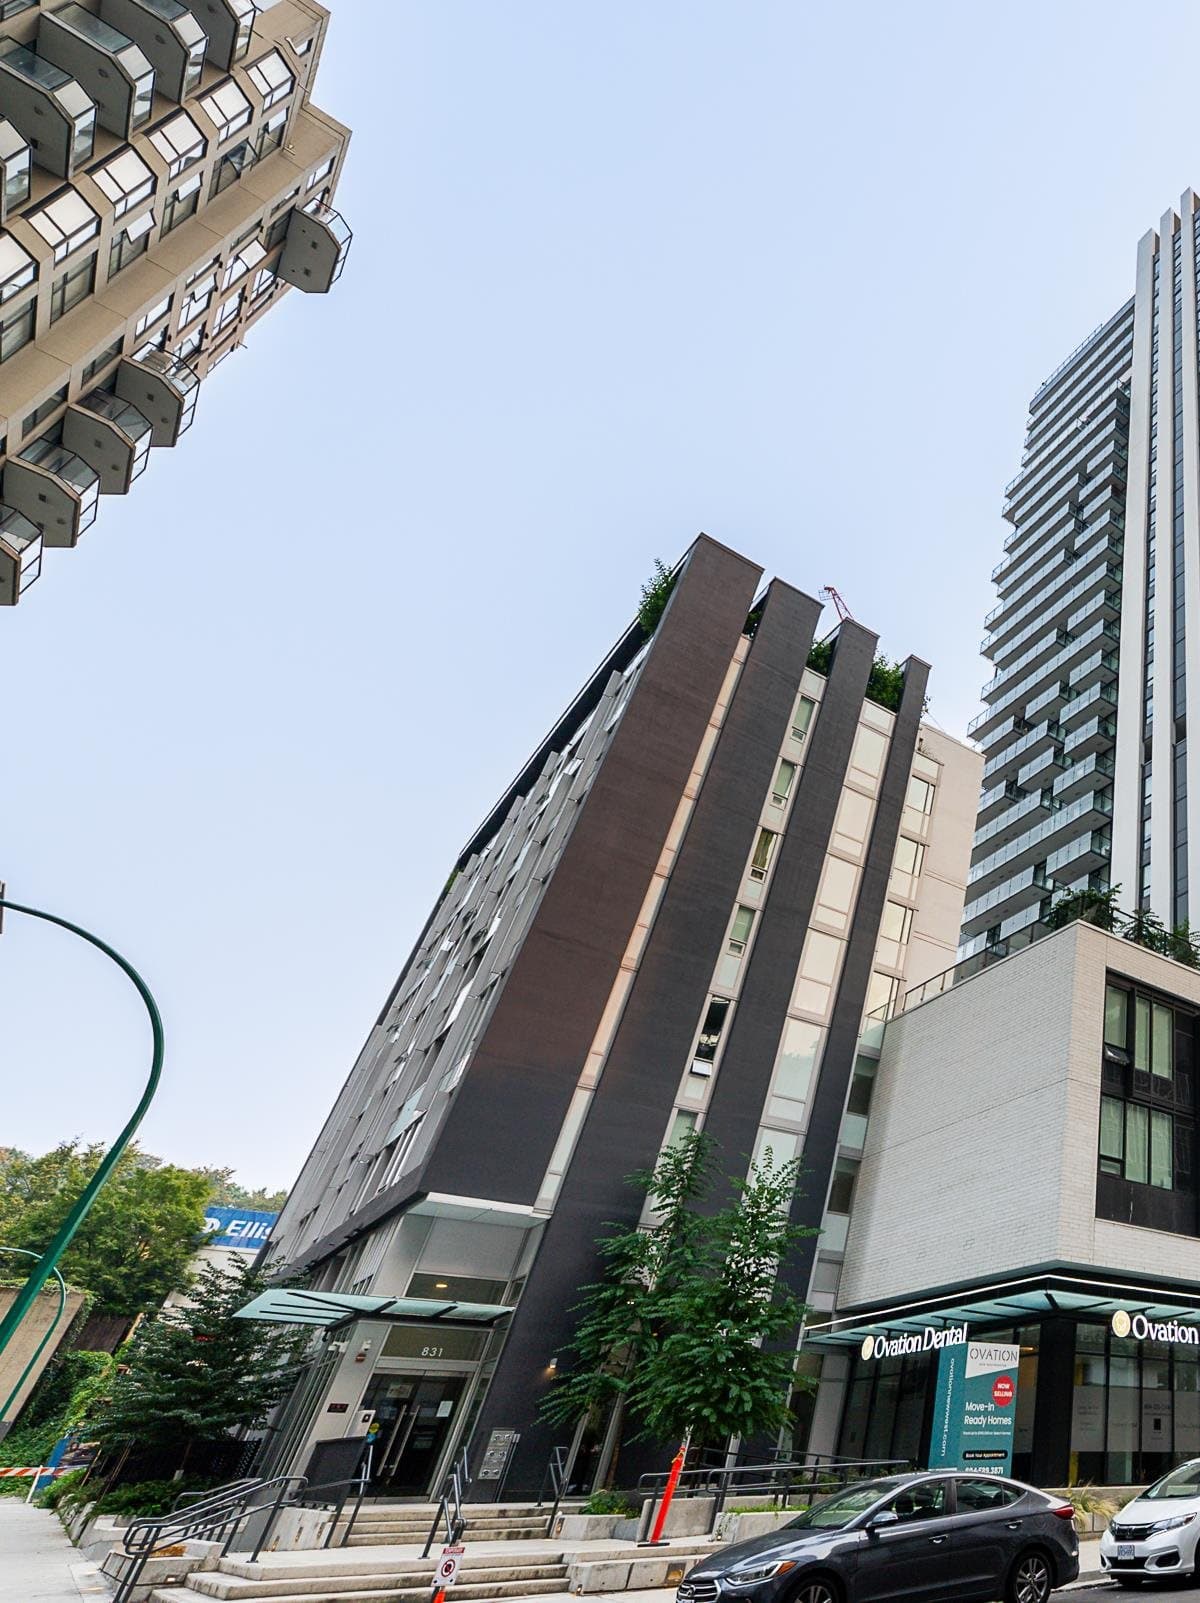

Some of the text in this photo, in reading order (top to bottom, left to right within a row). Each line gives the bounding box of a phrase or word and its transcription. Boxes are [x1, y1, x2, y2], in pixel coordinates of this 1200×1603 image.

[1132, 1315, 1199, 1345] Ovation
[874, 1322, 968, 1358] Ovation Dental
[421, 1346, 443, 1357] 831
[970, 1348, 1018, 1361] OVATION
[964, 1415, 1012, 1428] Ready Homes
